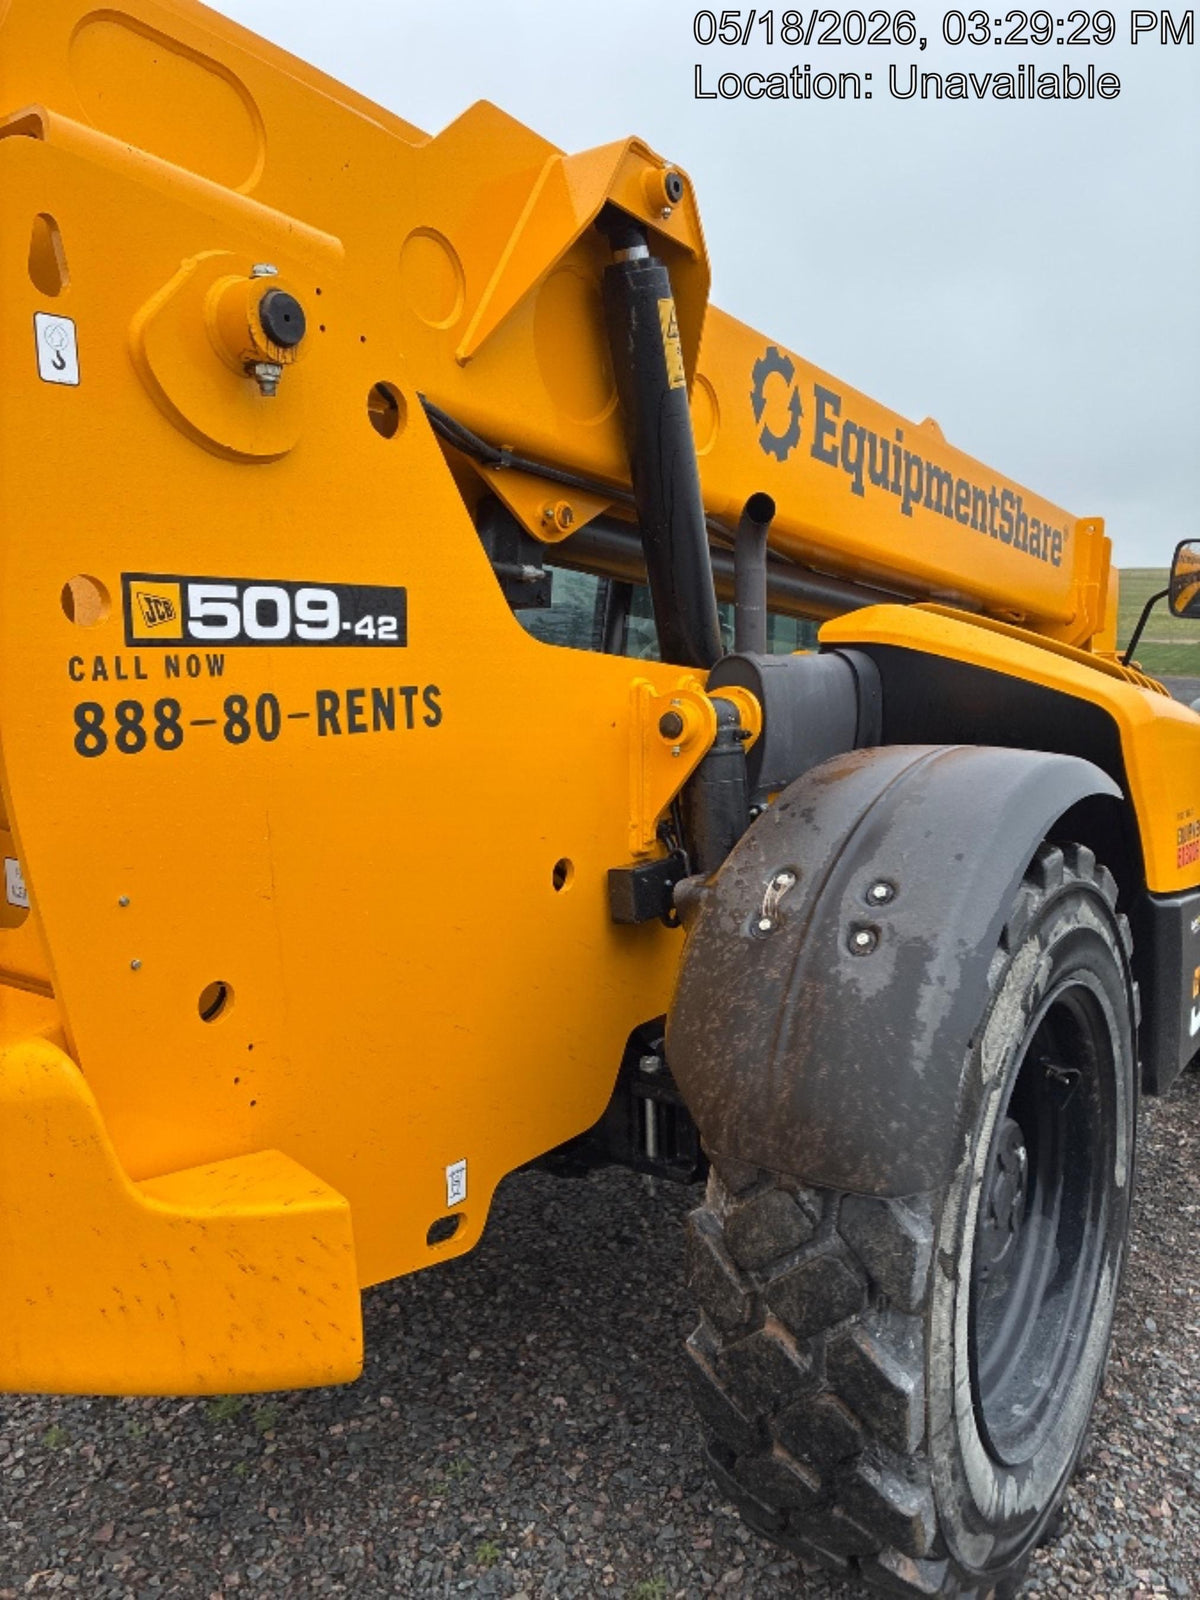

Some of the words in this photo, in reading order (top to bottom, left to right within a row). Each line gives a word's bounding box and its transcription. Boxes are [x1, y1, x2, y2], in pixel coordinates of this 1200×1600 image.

[810, 383, 1062, 566] EquipmentShare
[141, 595, 174, 624] JCB
[68, 655, 148, 682] CALL
[165, 653, 226, 678] NOW
[73, 684, 444, 758] 888-80-RENTS
